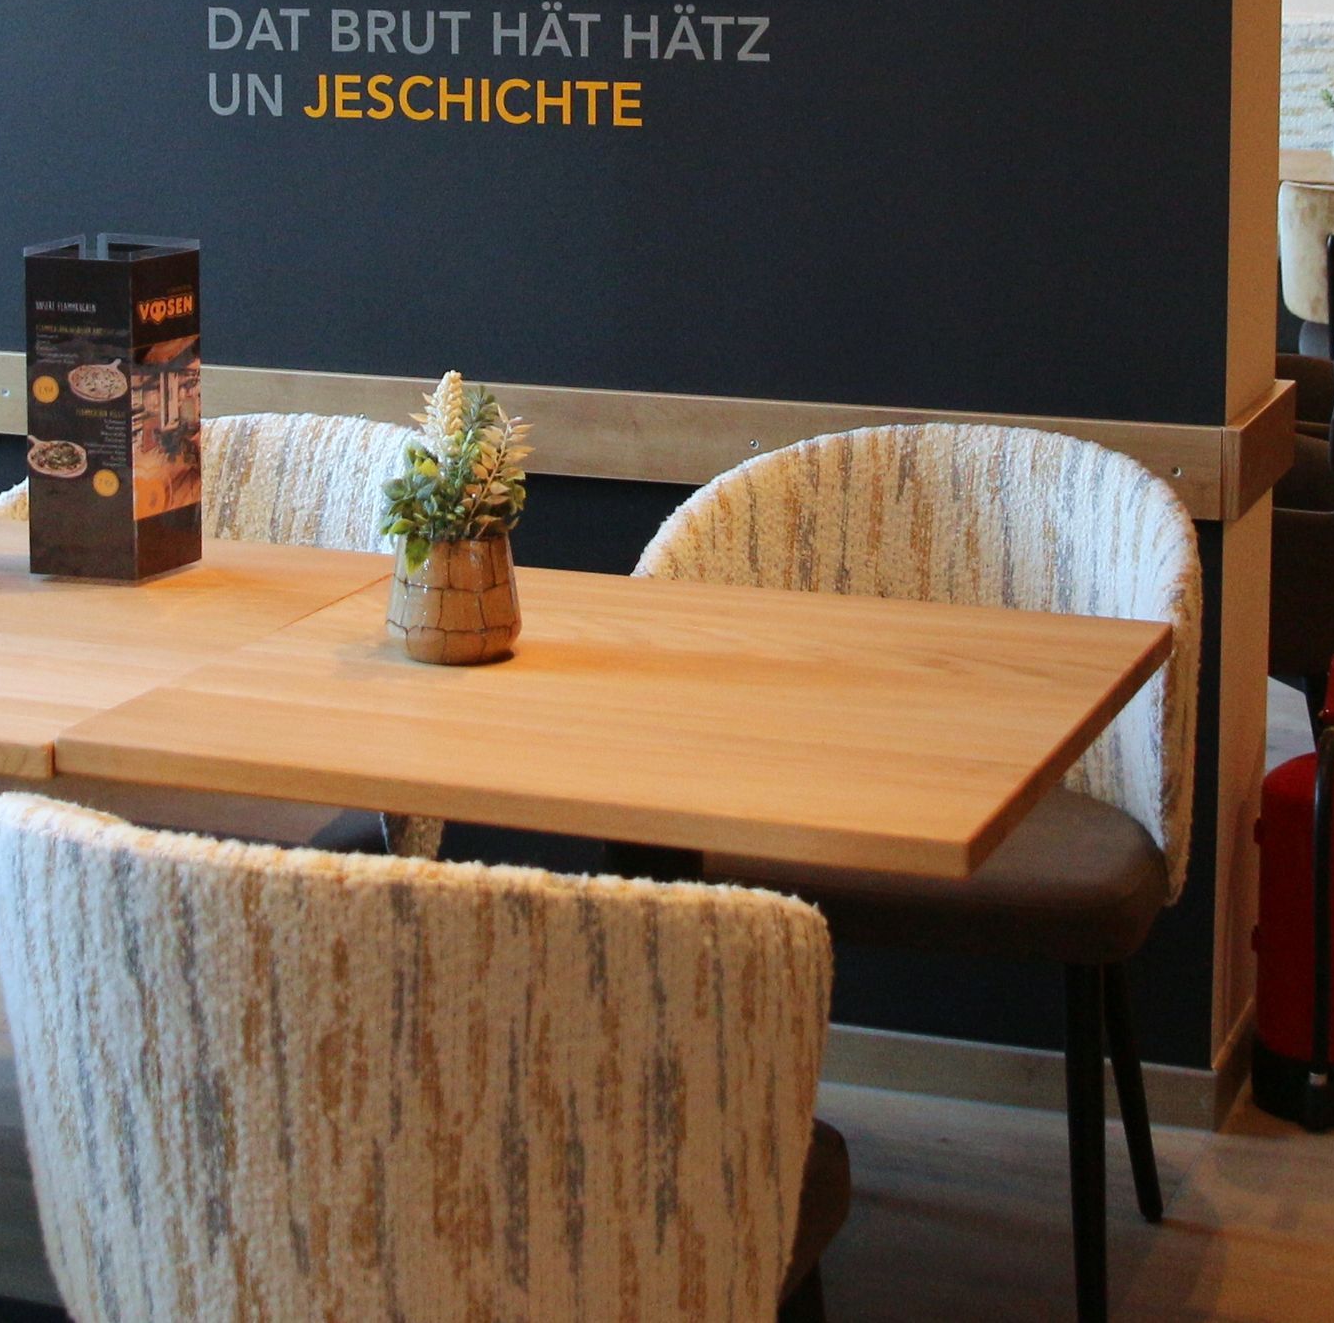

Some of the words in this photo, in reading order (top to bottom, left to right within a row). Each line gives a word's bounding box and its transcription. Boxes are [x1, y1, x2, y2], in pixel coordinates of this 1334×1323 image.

[208, 7, 310, 52] DAT
[331, 8, 471, 55] BRUT
[493, 1, 601, 57] HÄT
[623, 3, 770, 62] HÄTZ
[208, 73, 283, 117] UN
[303, 73, 642, 127] JESCHICHTE
